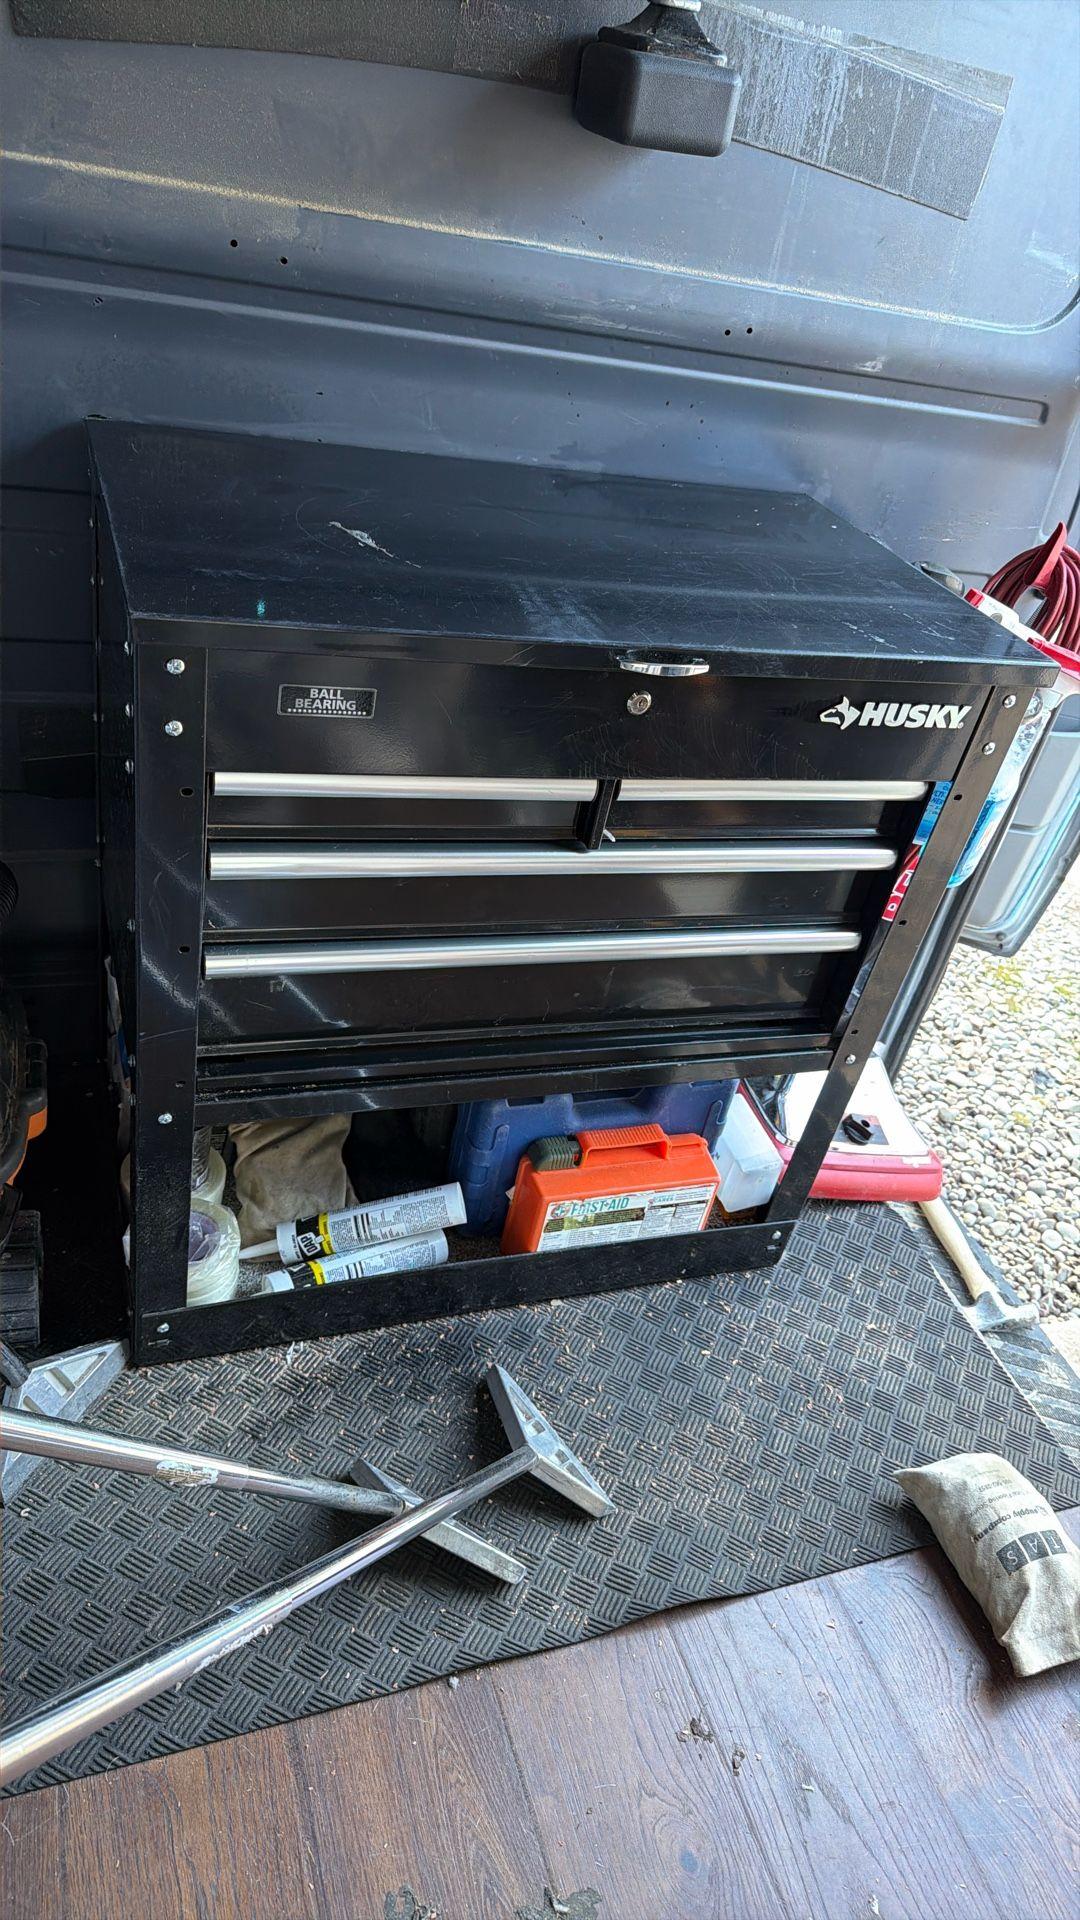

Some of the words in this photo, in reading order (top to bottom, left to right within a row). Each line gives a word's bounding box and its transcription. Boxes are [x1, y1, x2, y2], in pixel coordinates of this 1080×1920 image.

[310, 688, 344, 700] BALL
[295, 698, 357, 710] BEARING
[858, 702, 972, 729] HUSKY
[300, 1234, 318, 1254] DAP
[1012, 1507, 1039, 1519] supply
